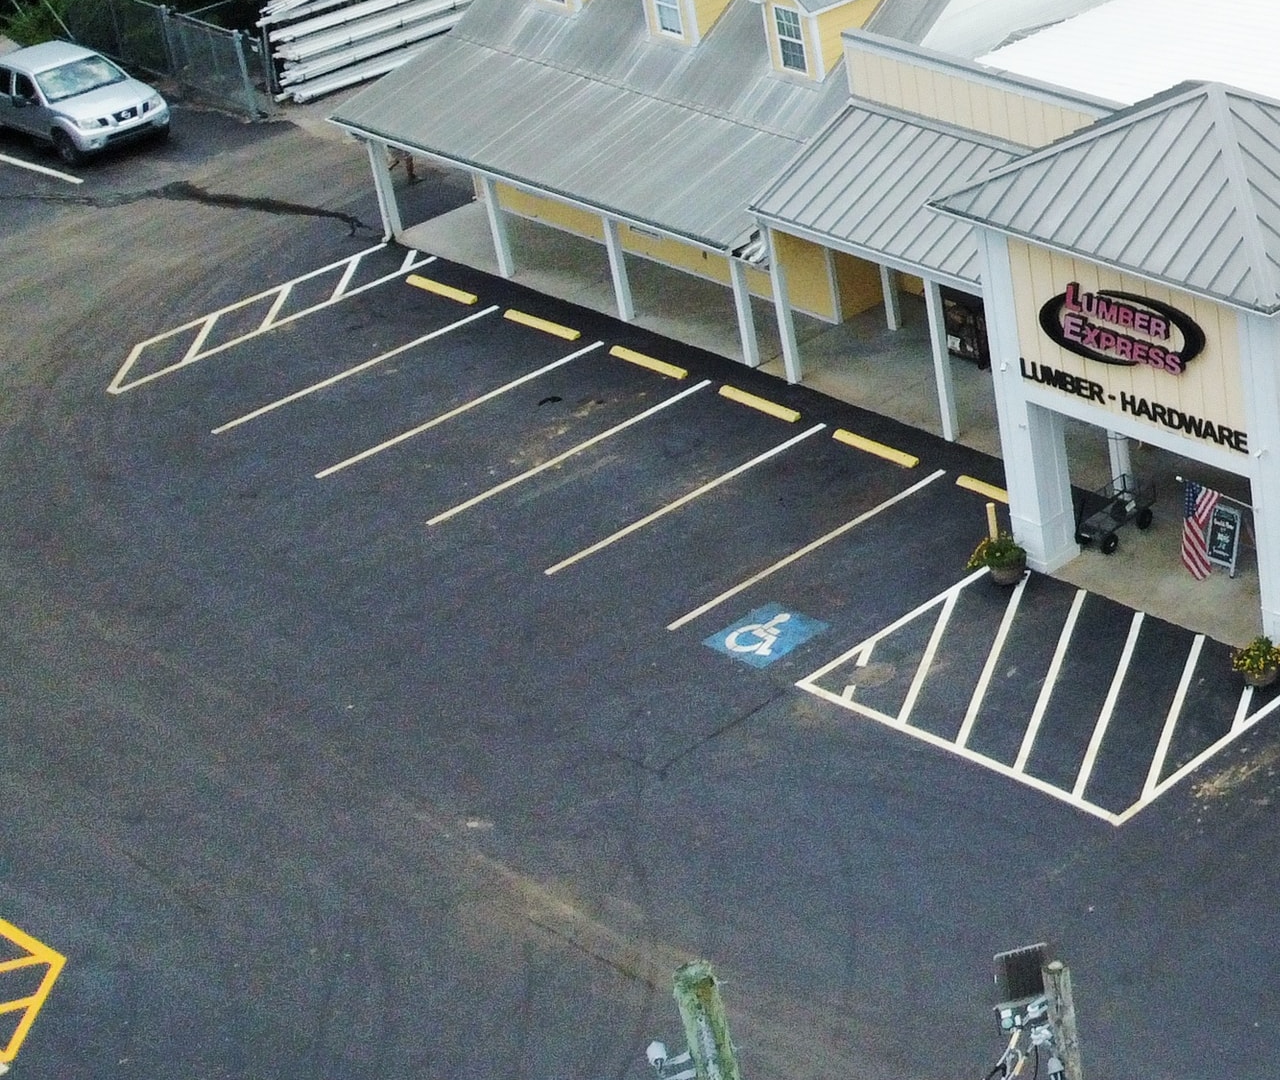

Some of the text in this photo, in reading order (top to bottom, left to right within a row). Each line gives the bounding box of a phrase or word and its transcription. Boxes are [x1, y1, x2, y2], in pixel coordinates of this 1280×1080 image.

[1063, 281, 1171, 341] LUMBER
[1063, 312, 1187, 376] EXPRESS
[1019, 357, 1106, 405] LUMBER
[1120, 390, 1250, 454] HARDWARE
